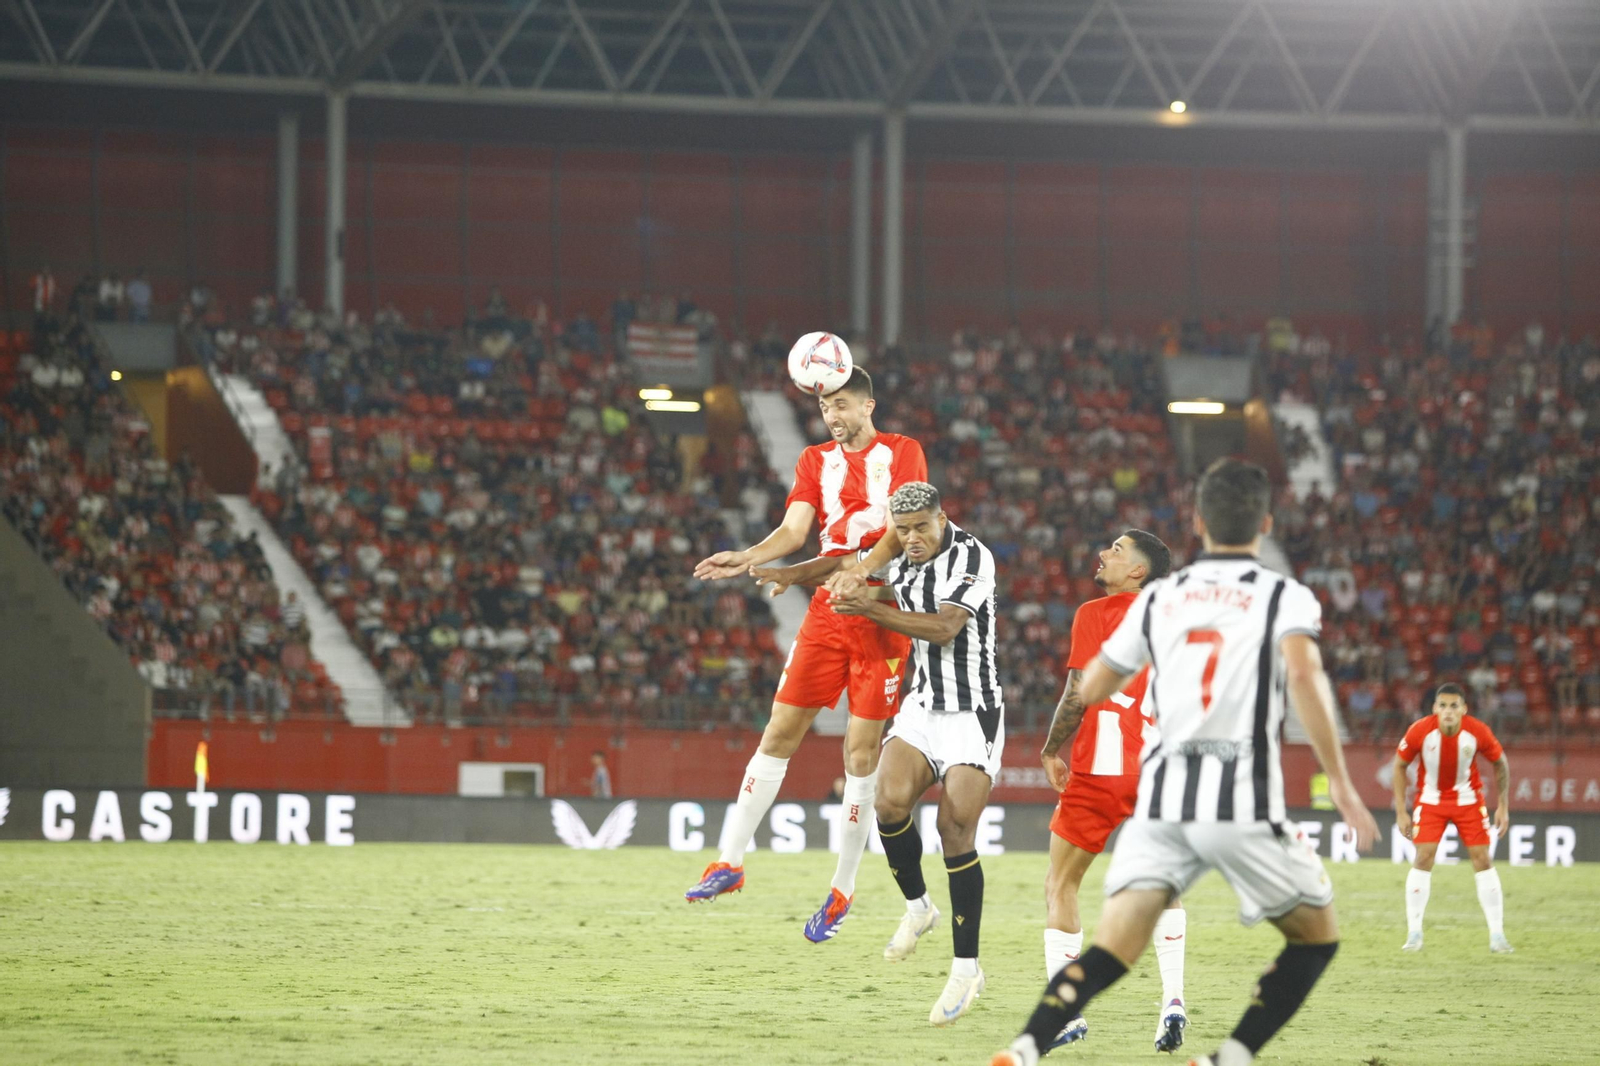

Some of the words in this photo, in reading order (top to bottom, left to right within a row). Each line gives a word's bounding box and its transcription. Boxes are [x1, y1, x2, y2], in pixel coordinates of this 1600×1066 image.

[1186, 629, 1224, 712] 7
[42, 789, 356, 846] CASTORE
[668, 801, 1005, 855] CSTRE
